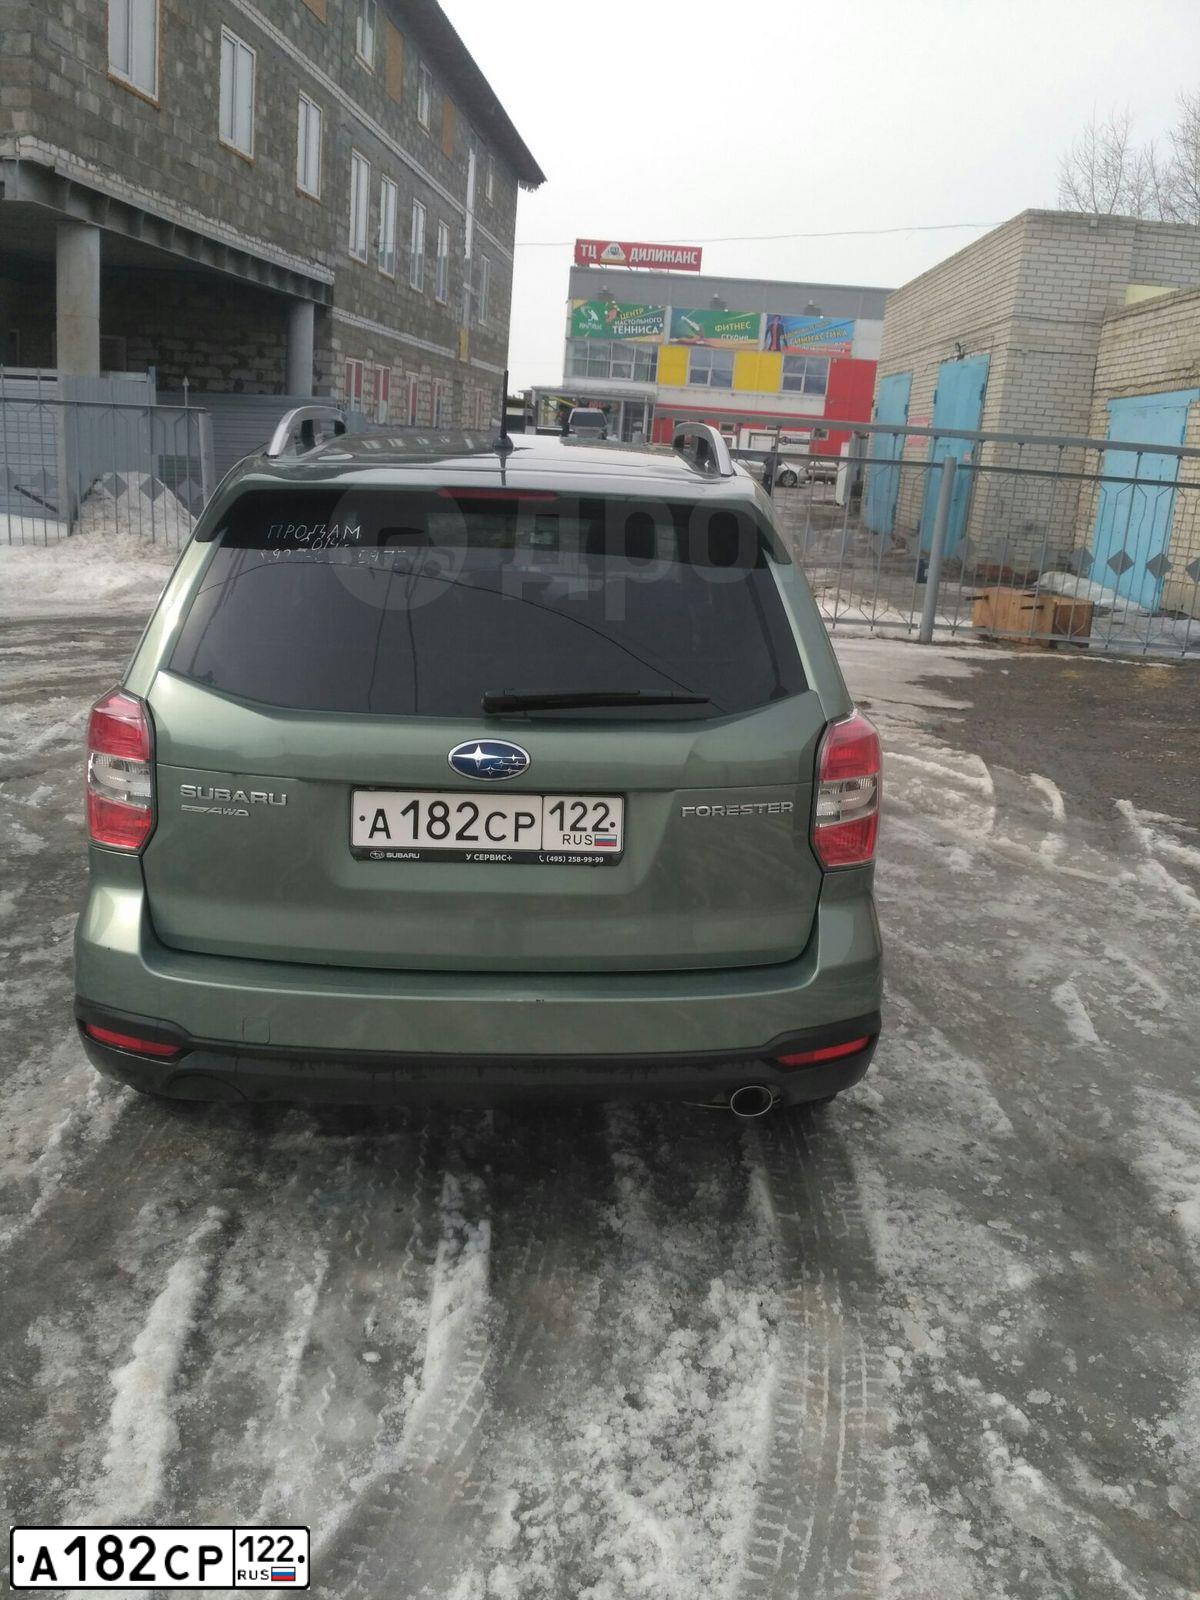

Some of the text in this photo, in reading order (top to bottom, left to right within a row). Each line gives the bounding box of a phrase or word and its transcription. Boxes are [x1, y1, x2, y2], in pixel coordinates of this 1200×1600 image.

[580, 243, 699, 265] ТЦ ДИЛИЖАНС
[620, 307, 645, 321] ЦЕНТР
[614, 316, 663, 326] НАСТОЛЬНОГО
[715, 321, 752, 332] ФИТНЕС
[612, 325, 660, 335] ТЕННИСА
[180, 784, 287, 806] SUBARU
[681, 801, 794, 817] FORESTER
[549, 801, 610, 832] 122
[562, 833, 593, 846] RUS
[474, 853, 513, 861] СЕРВИС+
[546, 855, 566, 863] (495)
